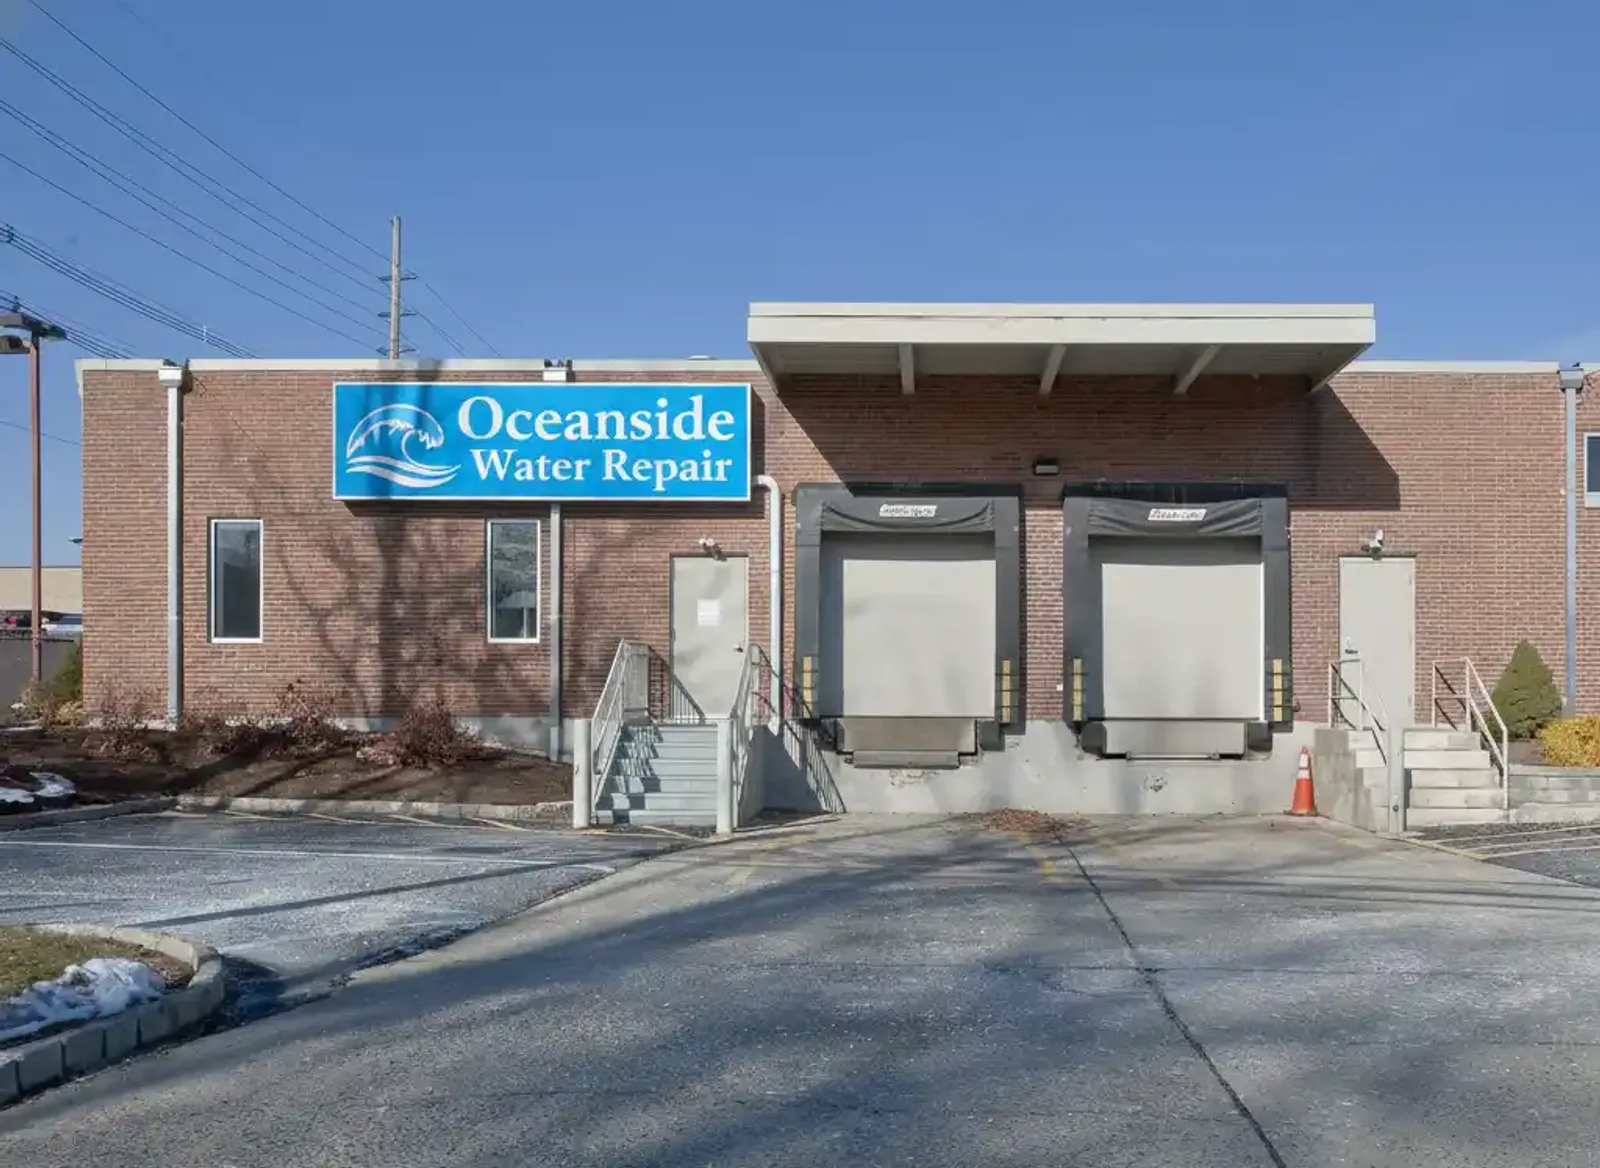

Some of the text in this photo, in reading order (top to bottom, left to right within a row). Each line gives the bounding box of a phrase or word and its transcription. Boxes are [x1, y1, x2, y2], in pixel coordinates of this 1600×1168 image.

[458, 395, 735, 441] Oceanside
[470, 449, 733, 491] Water Repair
